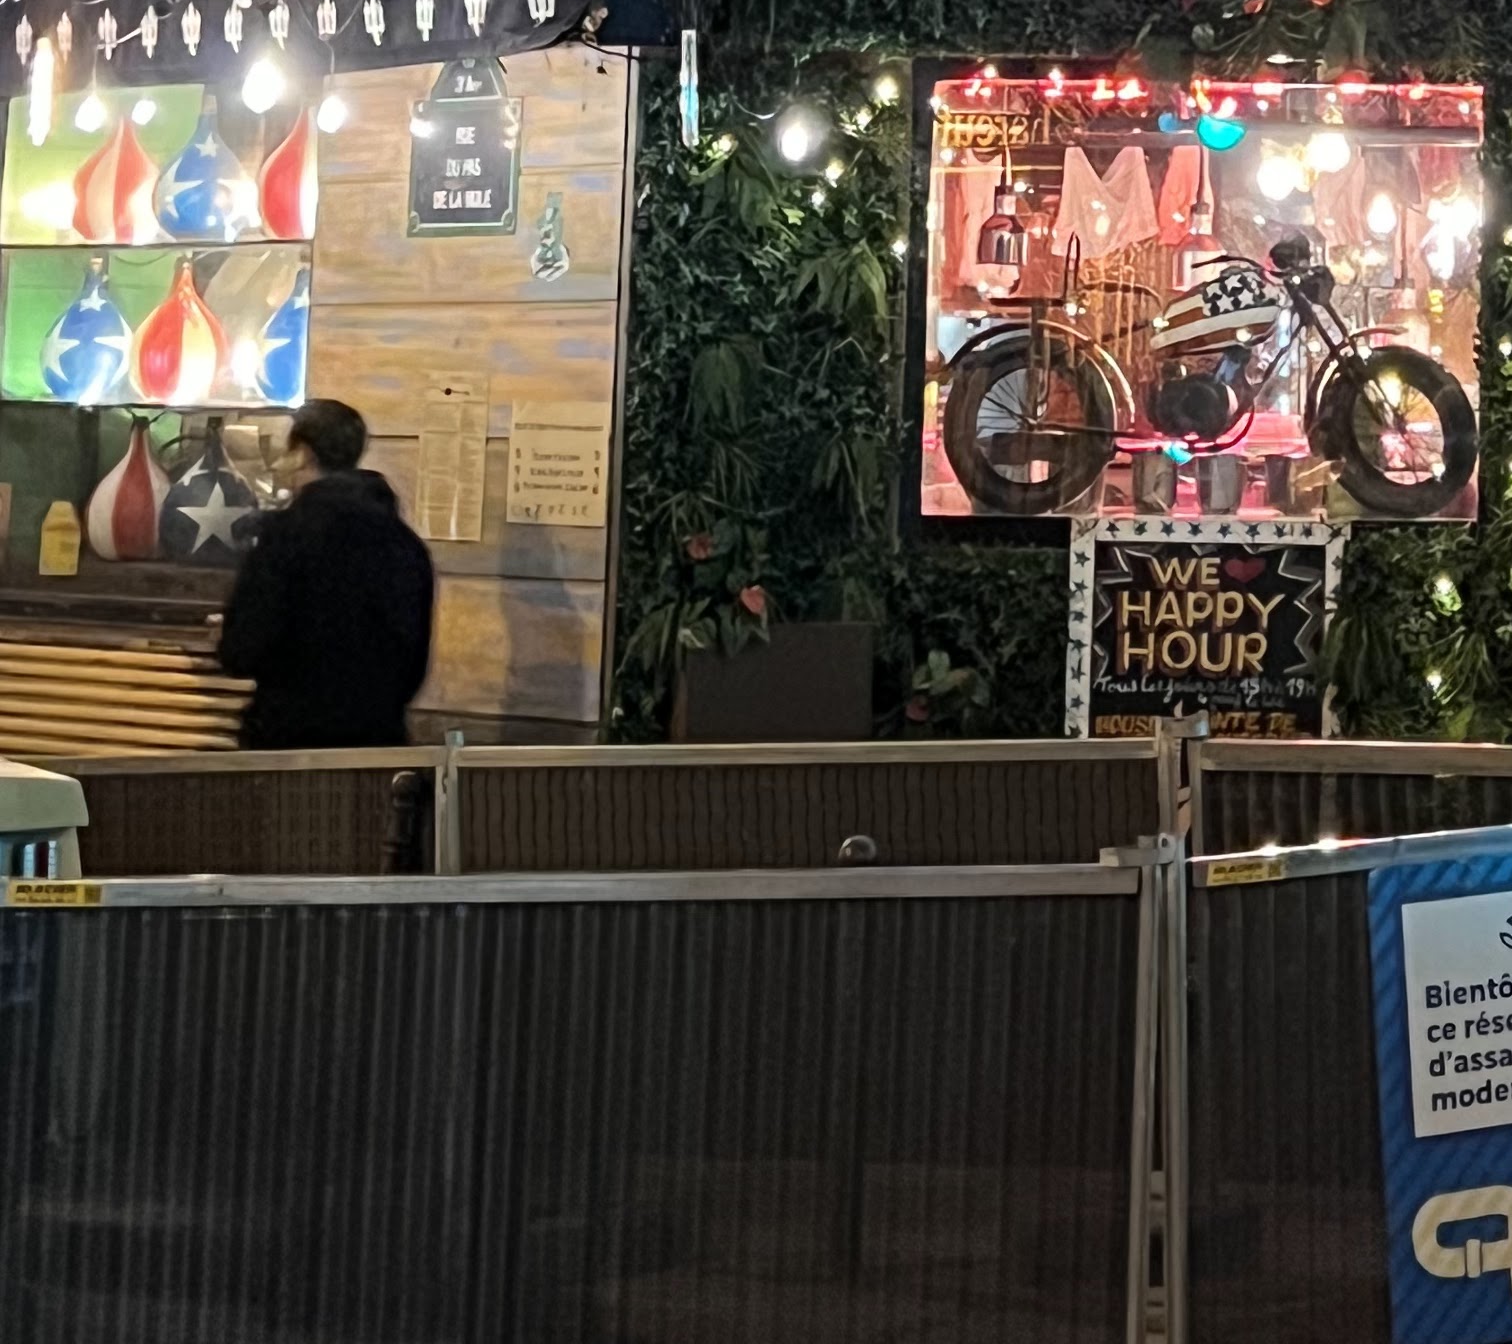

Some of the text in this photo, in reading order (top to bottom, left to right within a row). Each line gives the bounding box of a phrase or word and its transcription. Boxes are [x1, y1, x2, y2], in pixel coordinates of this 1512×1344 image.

[1151, 556, 1221, 587] WE
[1119, 590, 1286, 629] HAPPY
[1120, 630, 1268, 673] HOUR
[1427, 1021, 1457, 1043] ce
